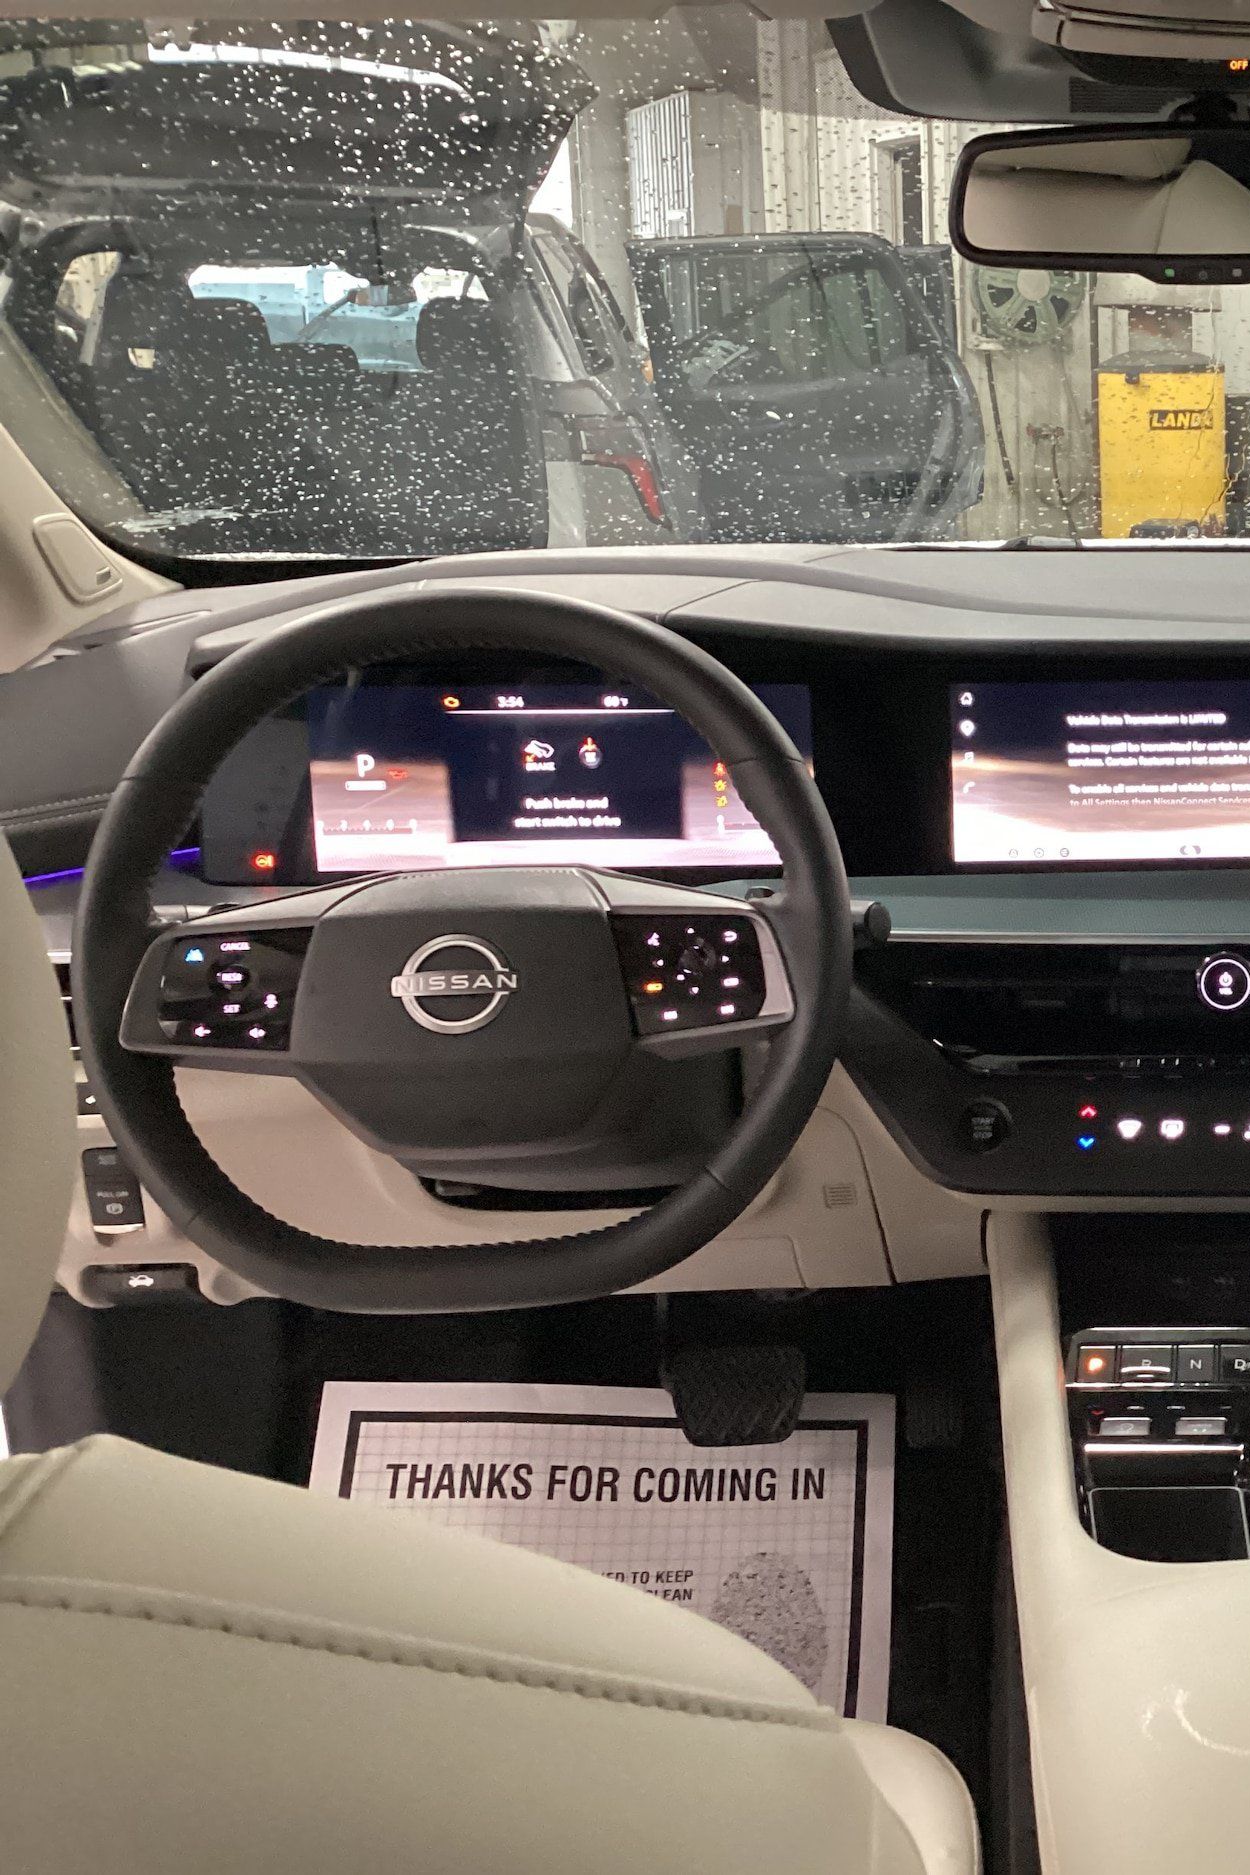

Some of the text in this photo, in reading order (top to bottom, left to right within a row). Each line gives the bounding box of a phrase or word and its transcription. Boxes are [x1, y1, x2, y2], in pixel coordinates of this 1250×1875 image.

[1229, 60, 1249, 71] OFF
[356, 754, 375, 778] P
[395, 974, 518, 994] NISSAN
[1089, 1357, 1103, 1372] P
[1190, 1359, 1202, 1370] N
[386, 1463, 826, 1502] THANKS FOR COMING IN
[631, 1571, 650, 1585] TO
[656, 1570, 694, 1583] KEEP
